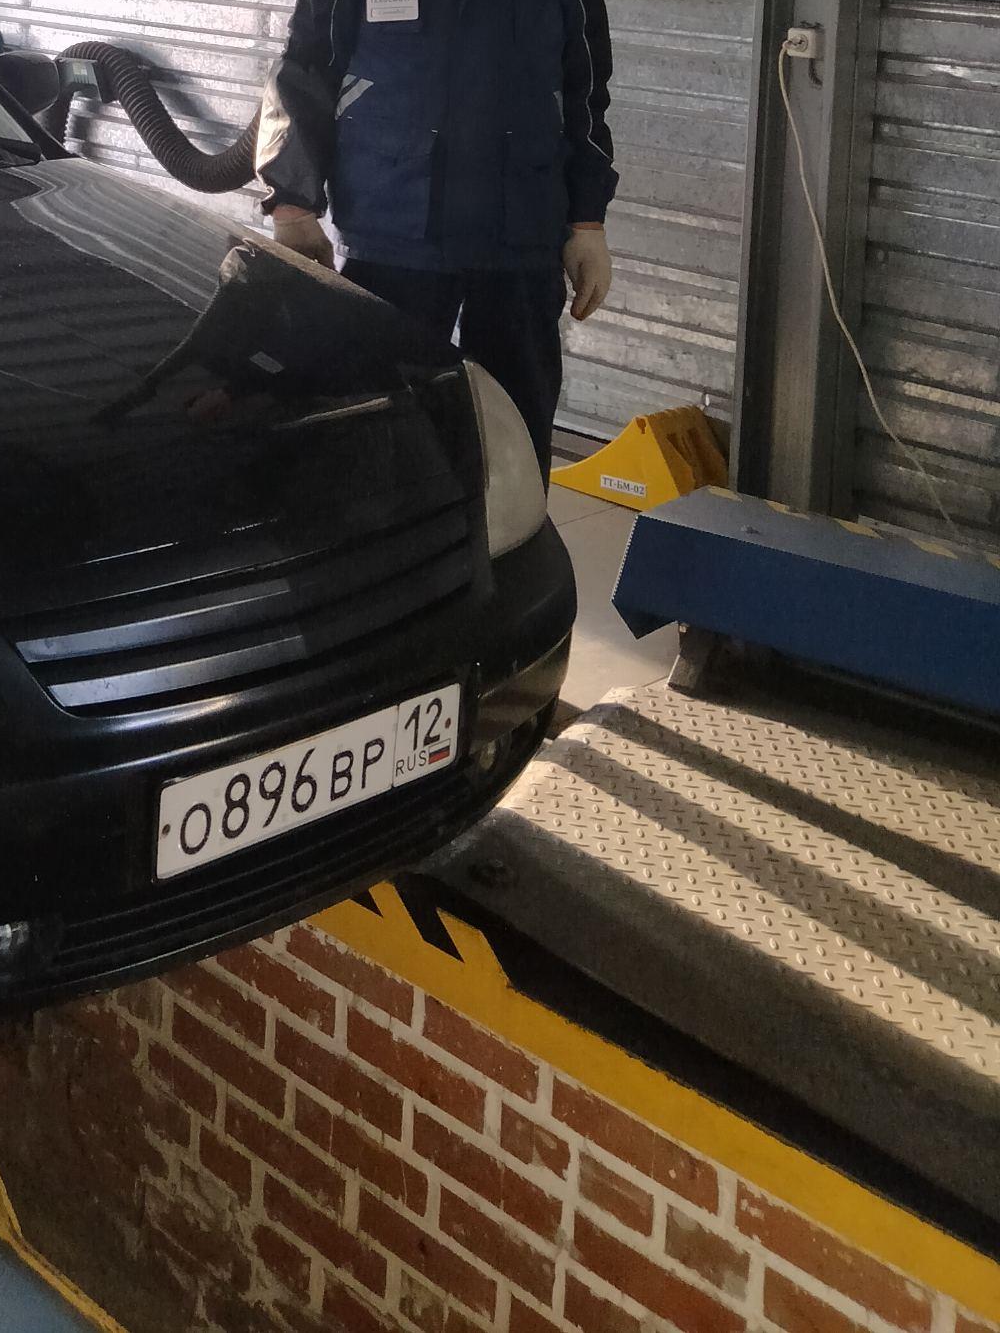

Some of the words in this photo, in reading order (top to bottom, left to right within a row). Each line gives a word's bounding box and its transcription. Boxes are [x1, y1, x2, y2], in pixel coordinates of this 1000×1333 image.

[602, 477, 644, 495] ТТ-БМ-02
[179, 737, 385, 855] О896ВР
[404, 698, 443, 751] 12
[395, 750, 427, 777] RUS
